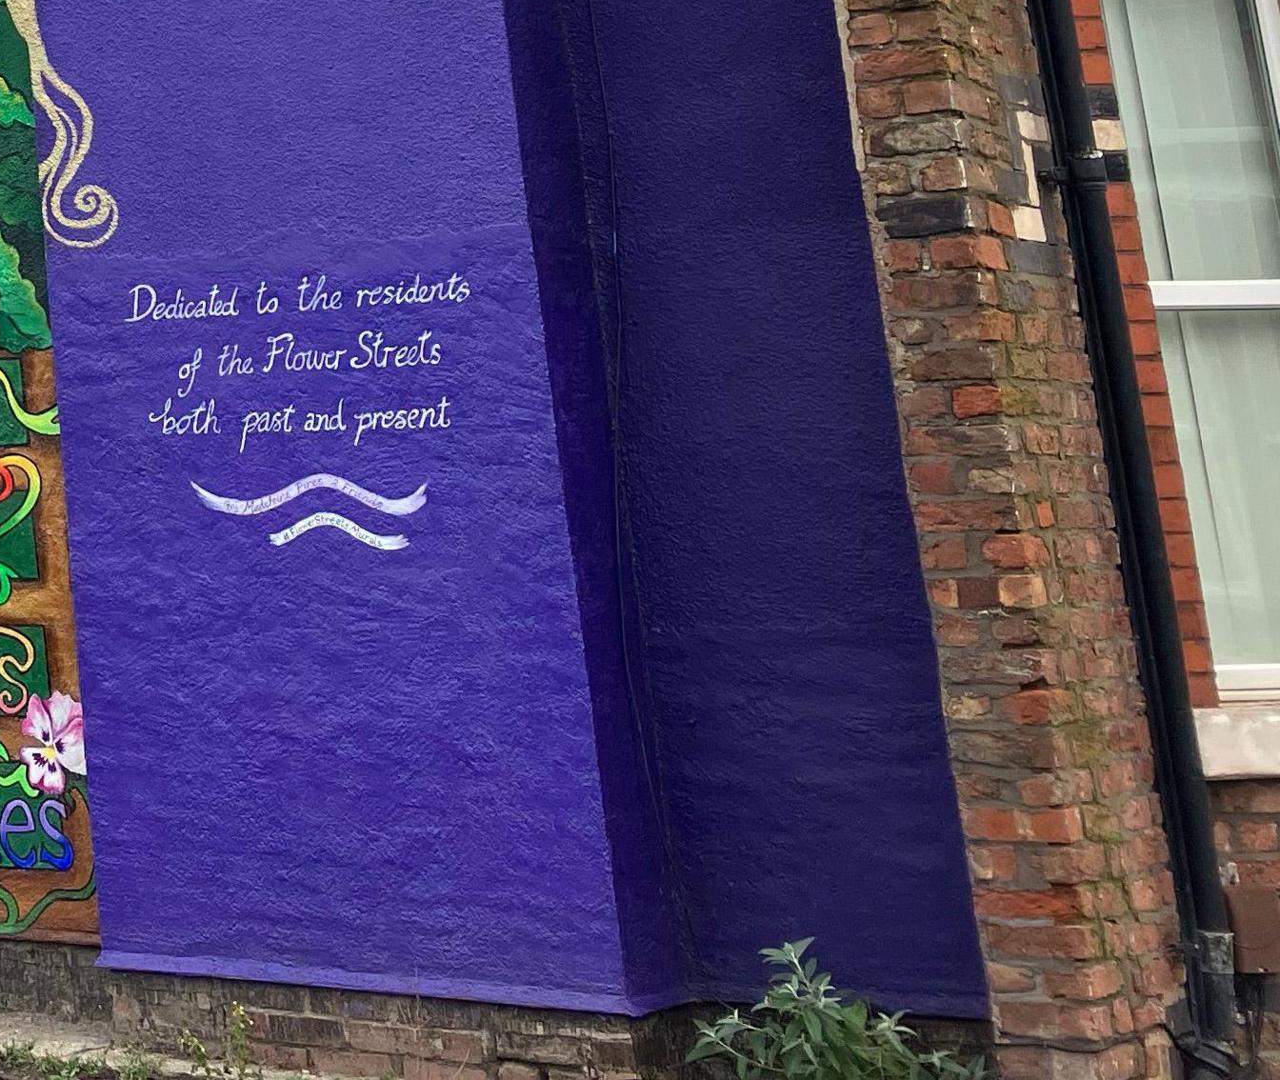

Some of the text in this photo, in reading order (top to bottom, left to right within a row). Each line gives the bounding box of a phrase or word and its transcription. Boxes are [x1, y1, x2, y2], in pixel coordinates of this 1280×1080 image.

[125, 272, 472, 322] Dedicated to the residents
[177, 330, 443, 397] of the Flower Streets
[148, 395, 453, 455] both past and present
